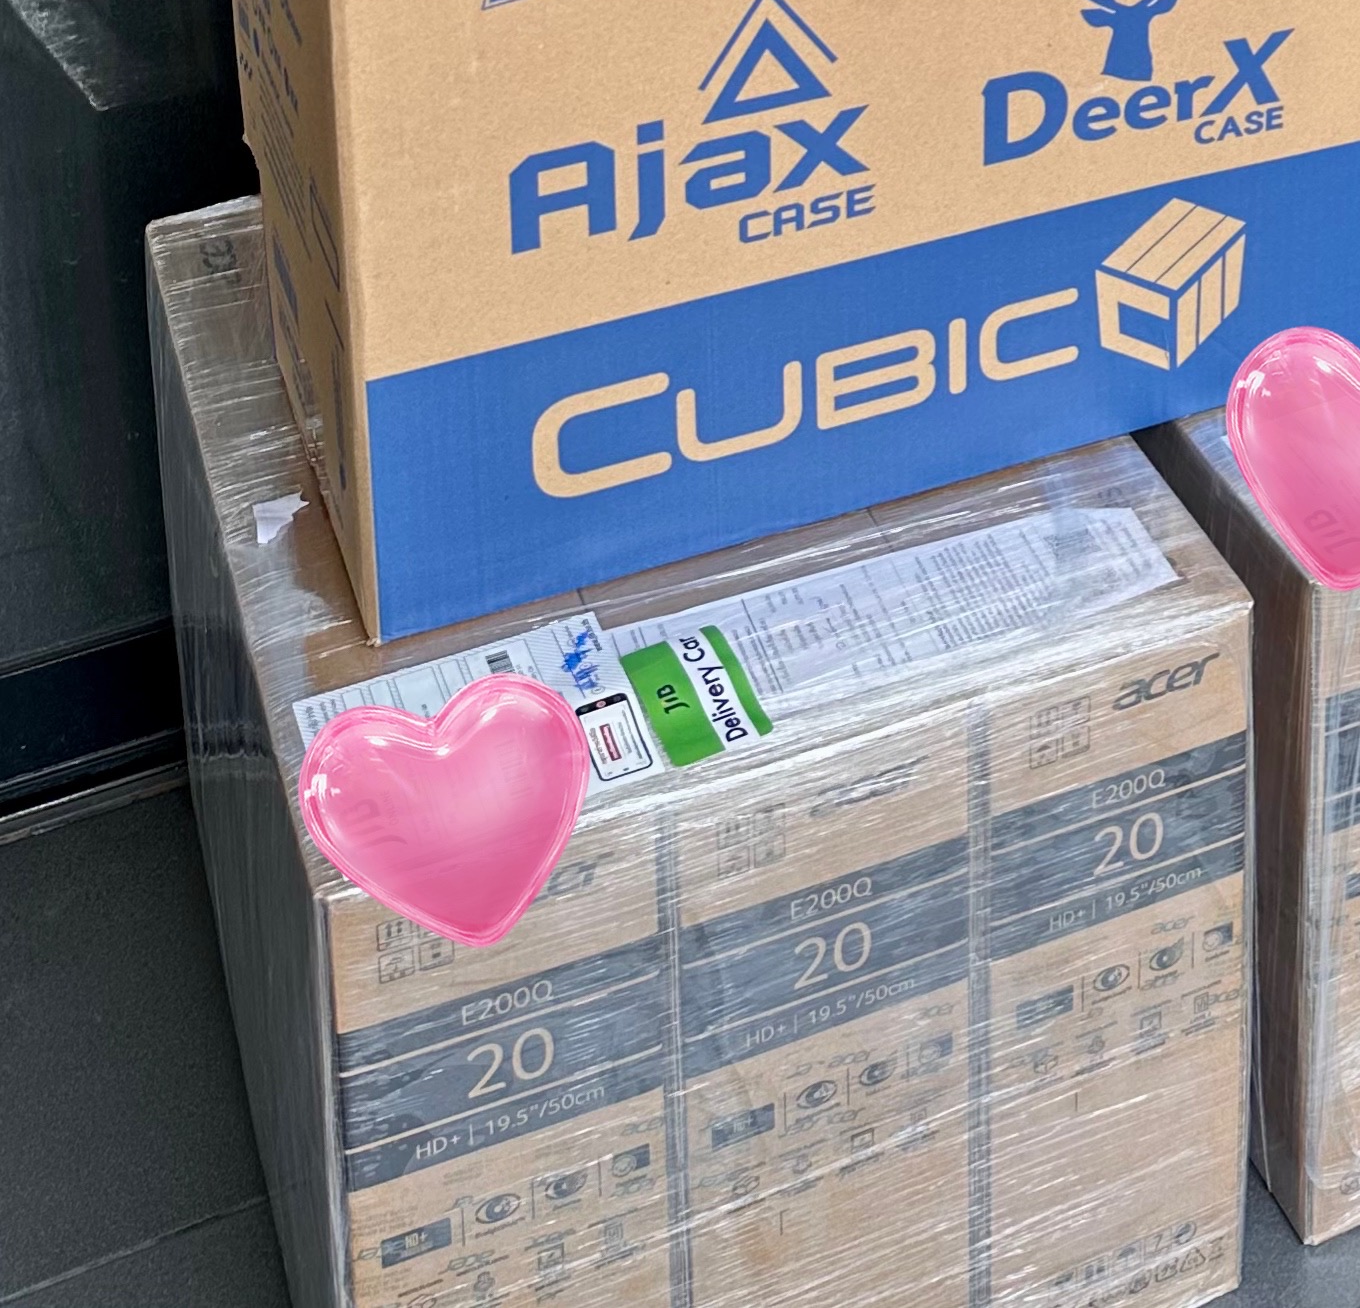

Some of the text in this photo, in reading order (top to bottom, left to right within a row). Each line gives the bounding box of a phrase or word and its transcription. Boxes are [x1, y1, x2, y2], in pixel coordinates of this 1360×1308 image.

[981, 27, 1297, 168] DeerX
[1193, 105, 1285, 146] CASE
[508, 103, 872, 257] Ajax
[737, 184, 878, 245] CASE
[531, 286, 1080, 500] CUBIC
[656, 684, 690, 715] JIB
[678, 636, 749, 742] Delivery Car
[1111, 651, 1221, 711] acer
[1091, 811, 1166, 879] 20
[789, 877, 874, 922] E200Q
[794, 920, 873, 991] 20
[460, 979, 554, 1027] E200Q
[466, 1025, 556, 1100] 20
